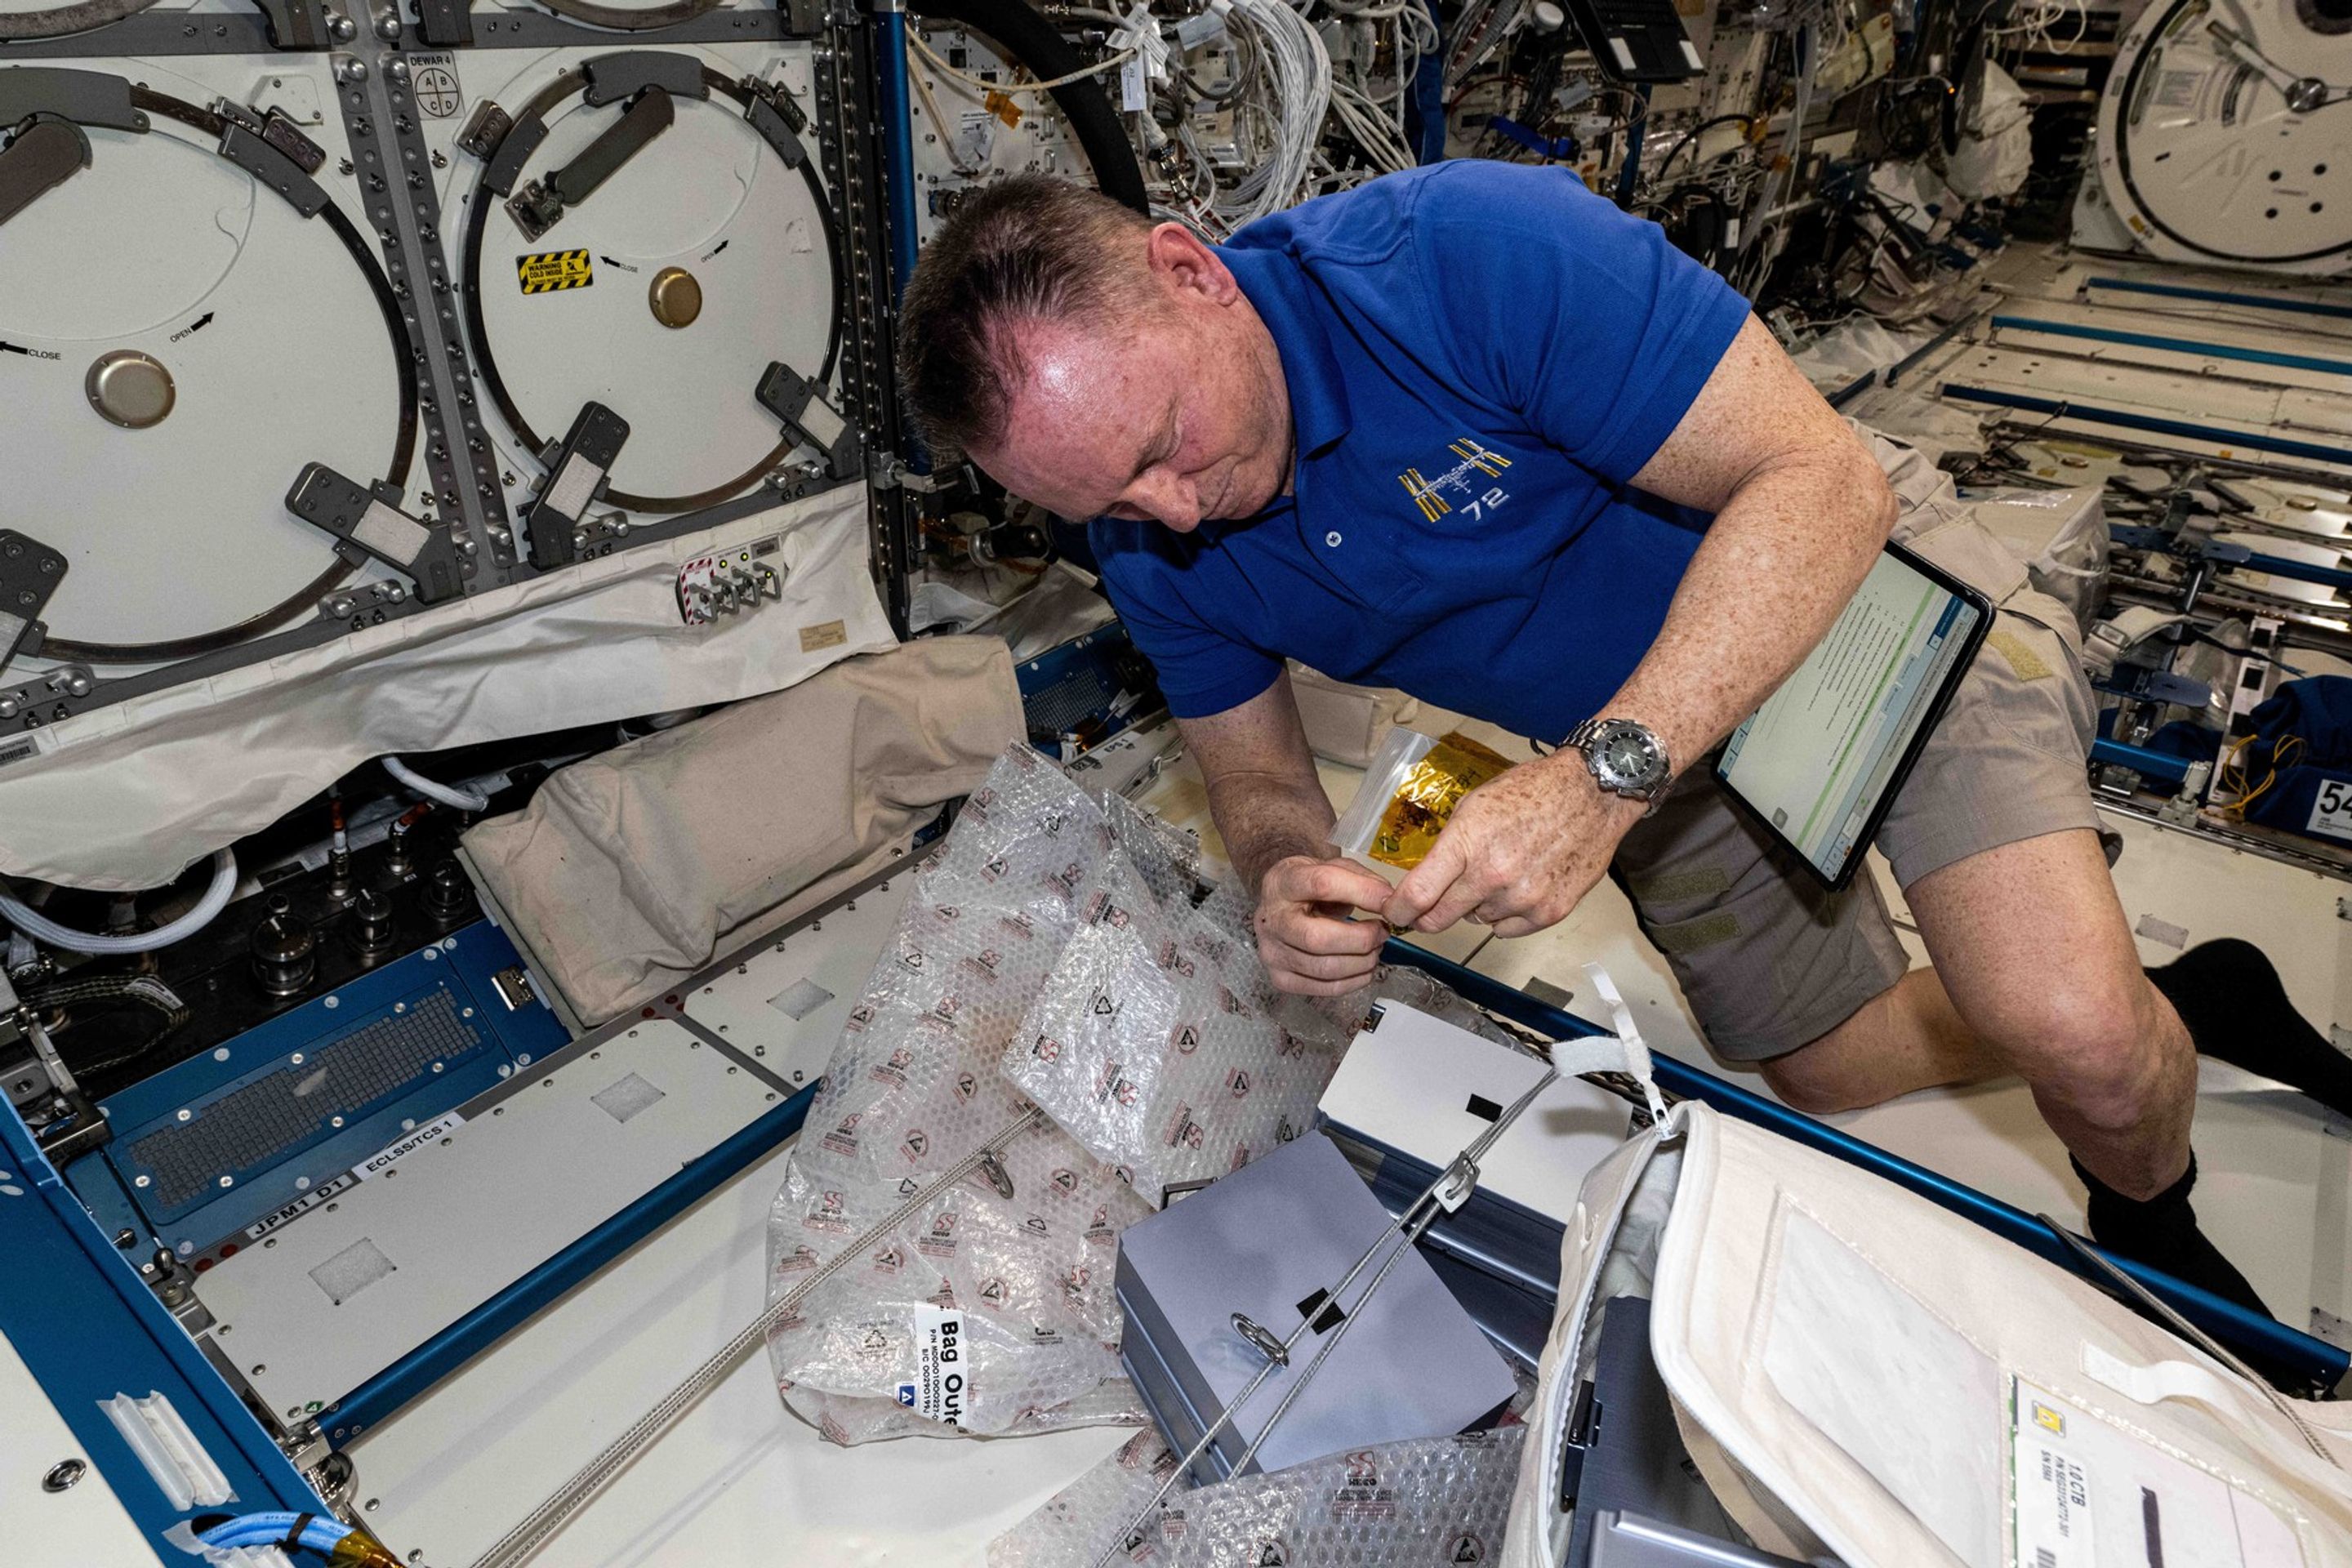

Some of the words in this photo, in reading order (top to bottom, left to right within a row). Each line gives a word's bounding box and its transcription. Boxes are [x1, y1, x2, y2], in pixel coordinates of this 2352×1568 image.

[410, 56, 444, 66] DEWAR
[445, 56, 452, 65] 4
[425, 77, 433, 87] A
[440, 76, 448, 86] B
[430, 100, 438, 110] C
[445, 100, 452, 109] D
[701, 252, 715, 263] OPEN
[528, 261, 562, 272] WARNING
[546, 268, 564, 277] INSIDE
[619, 263, 639, 274] CLOSE
[169, 327, 193, 344] OPEN
[28, 349, 61, 361] CLOSE
[1459, 487, 1510, 522] 72
[2319, 782, 2352, 820] 54
[366, 1126, 443, 1173] ECLSS/TCS
[443, 1120, 453, 1128] 1
[255, 1198, 310, 1235] JPM1
[315, 1179, 343, 1199] D1
[929, 1329, 938, 1343] P/N
[940, 1321, 959, 1363] Bag
[2070, 1481, 2086, 1508] CTB
